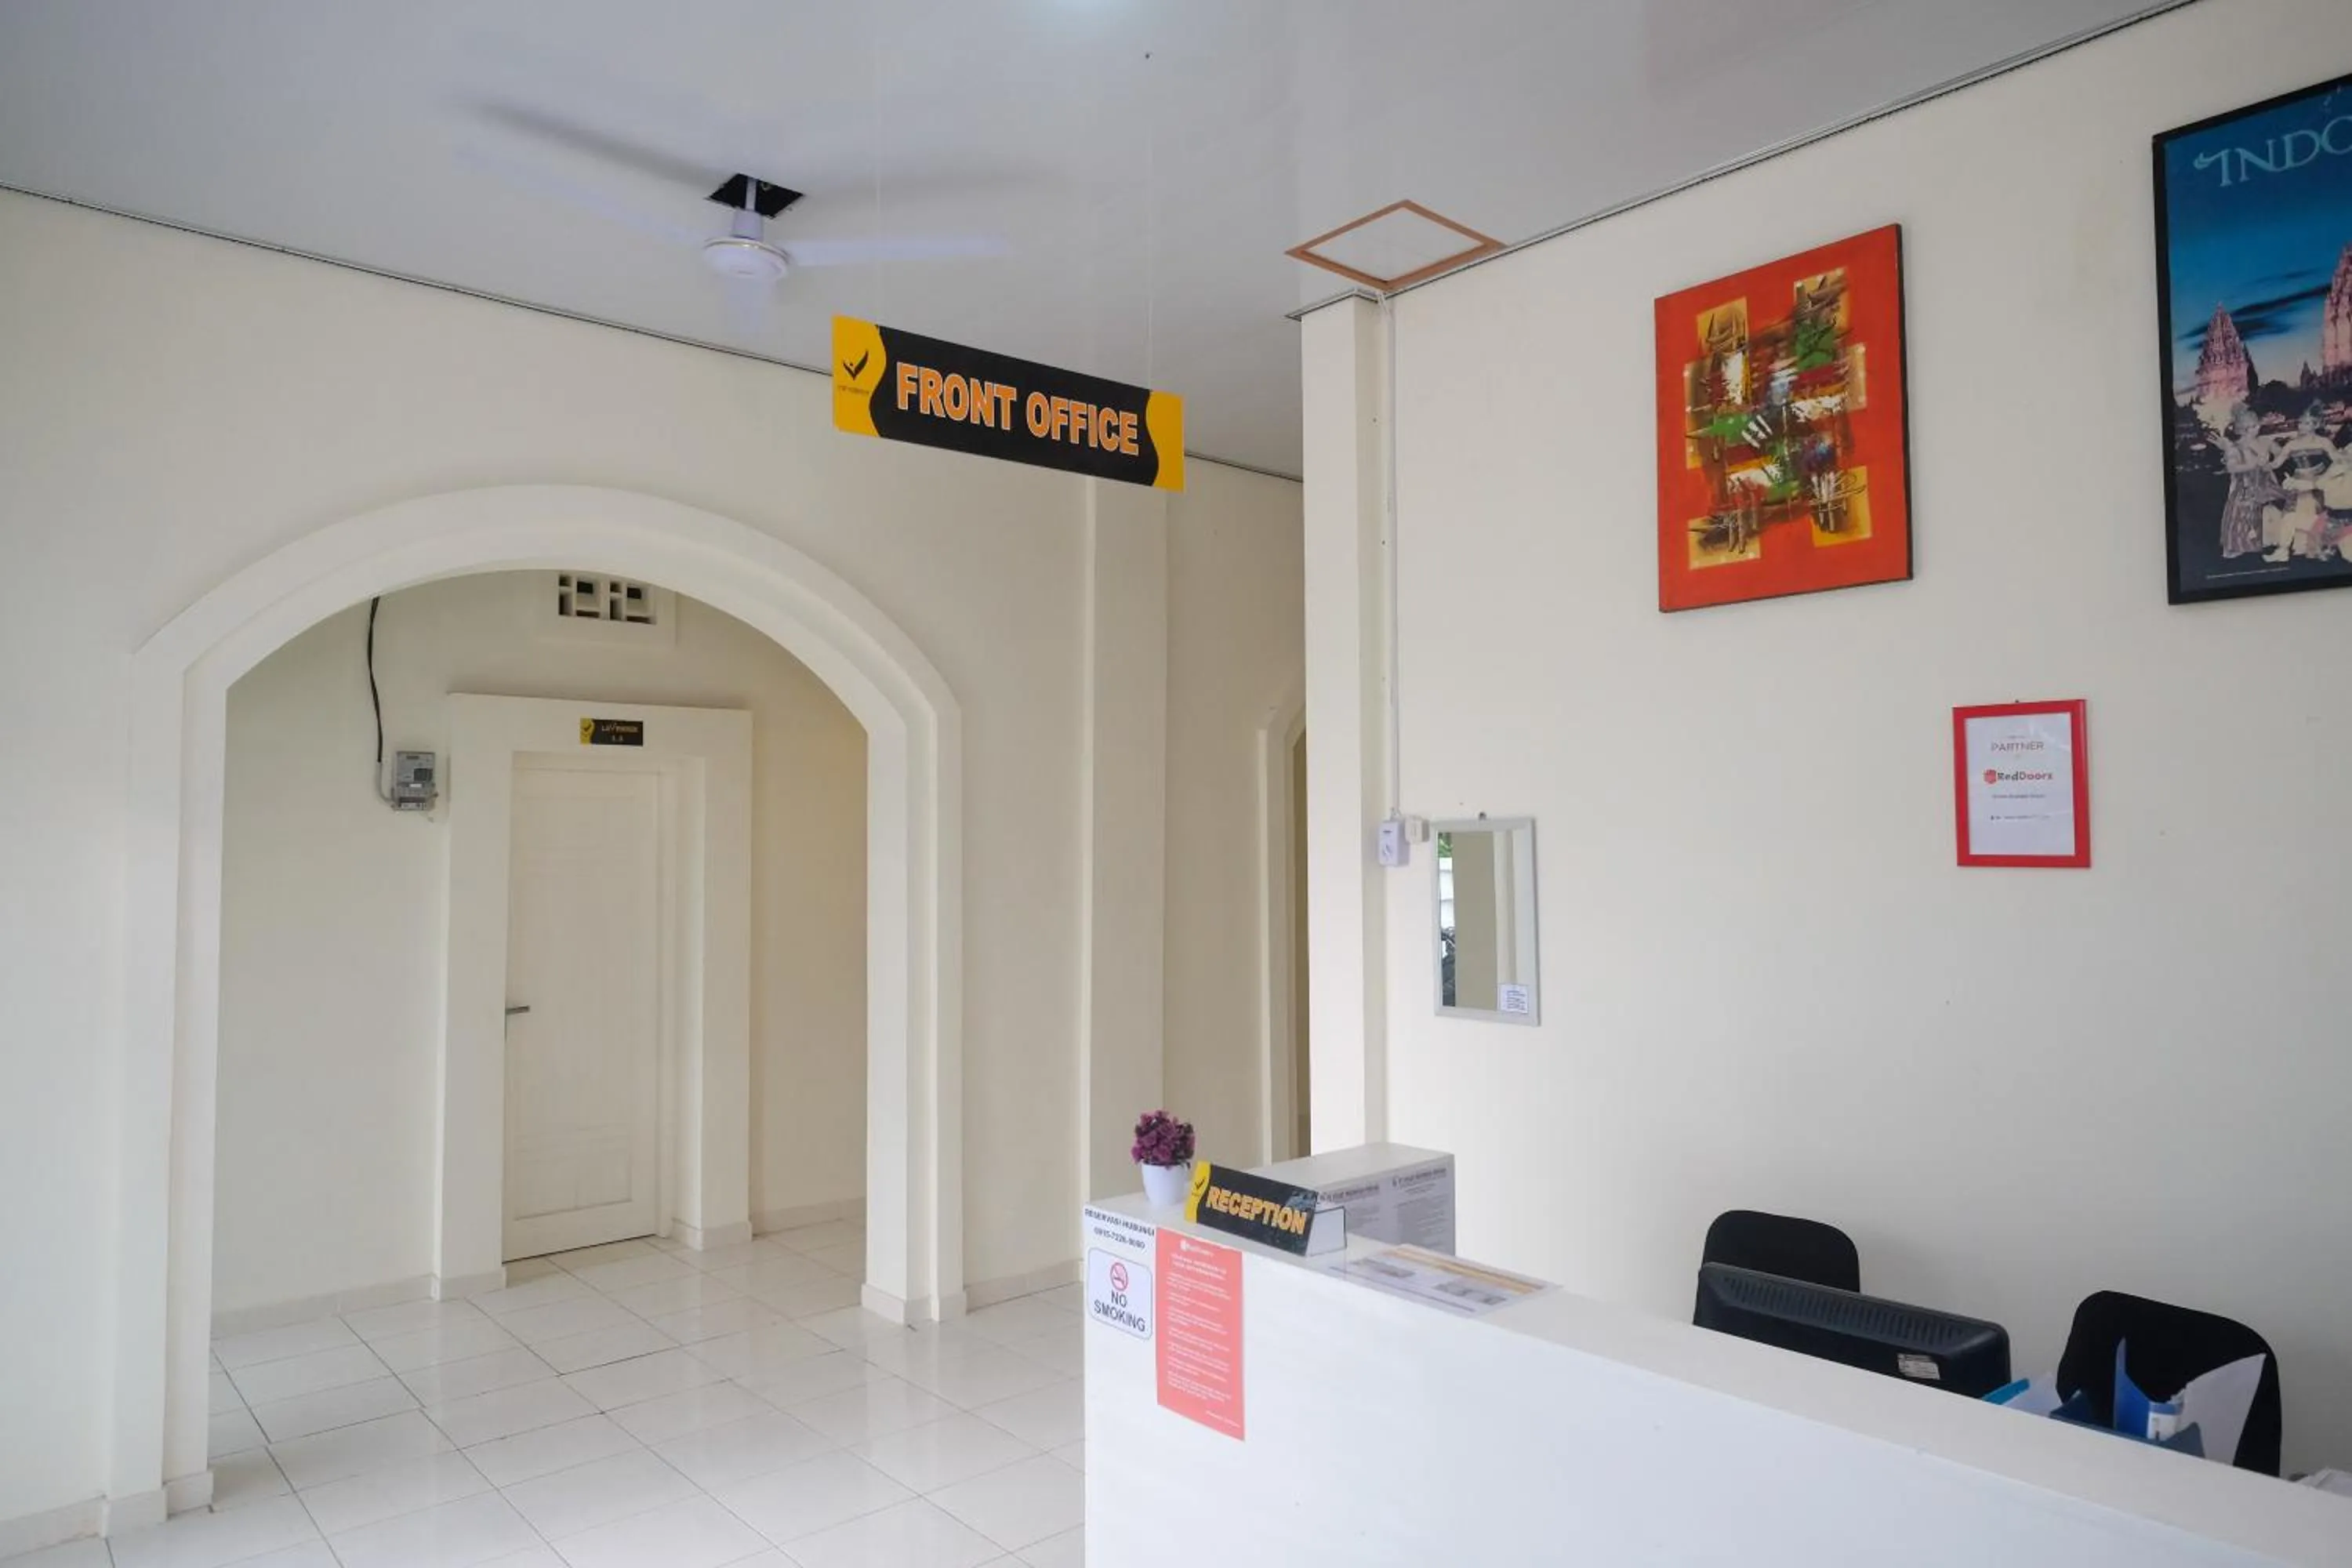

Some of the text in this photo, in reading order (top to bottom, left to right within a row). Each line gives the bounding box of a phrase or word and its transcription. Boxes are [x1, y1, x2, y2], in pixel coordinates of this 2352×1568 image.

[896, 361, 1139, 456] FRONT OFFICE
[1991, 741, 2045, 753] PARTNER
[1206, 1185, 1307, 1235] RECEPTION
[1094, 1298, 1145, 1332] SMOKING
[1111, 1290, 1127, 1308] NO
